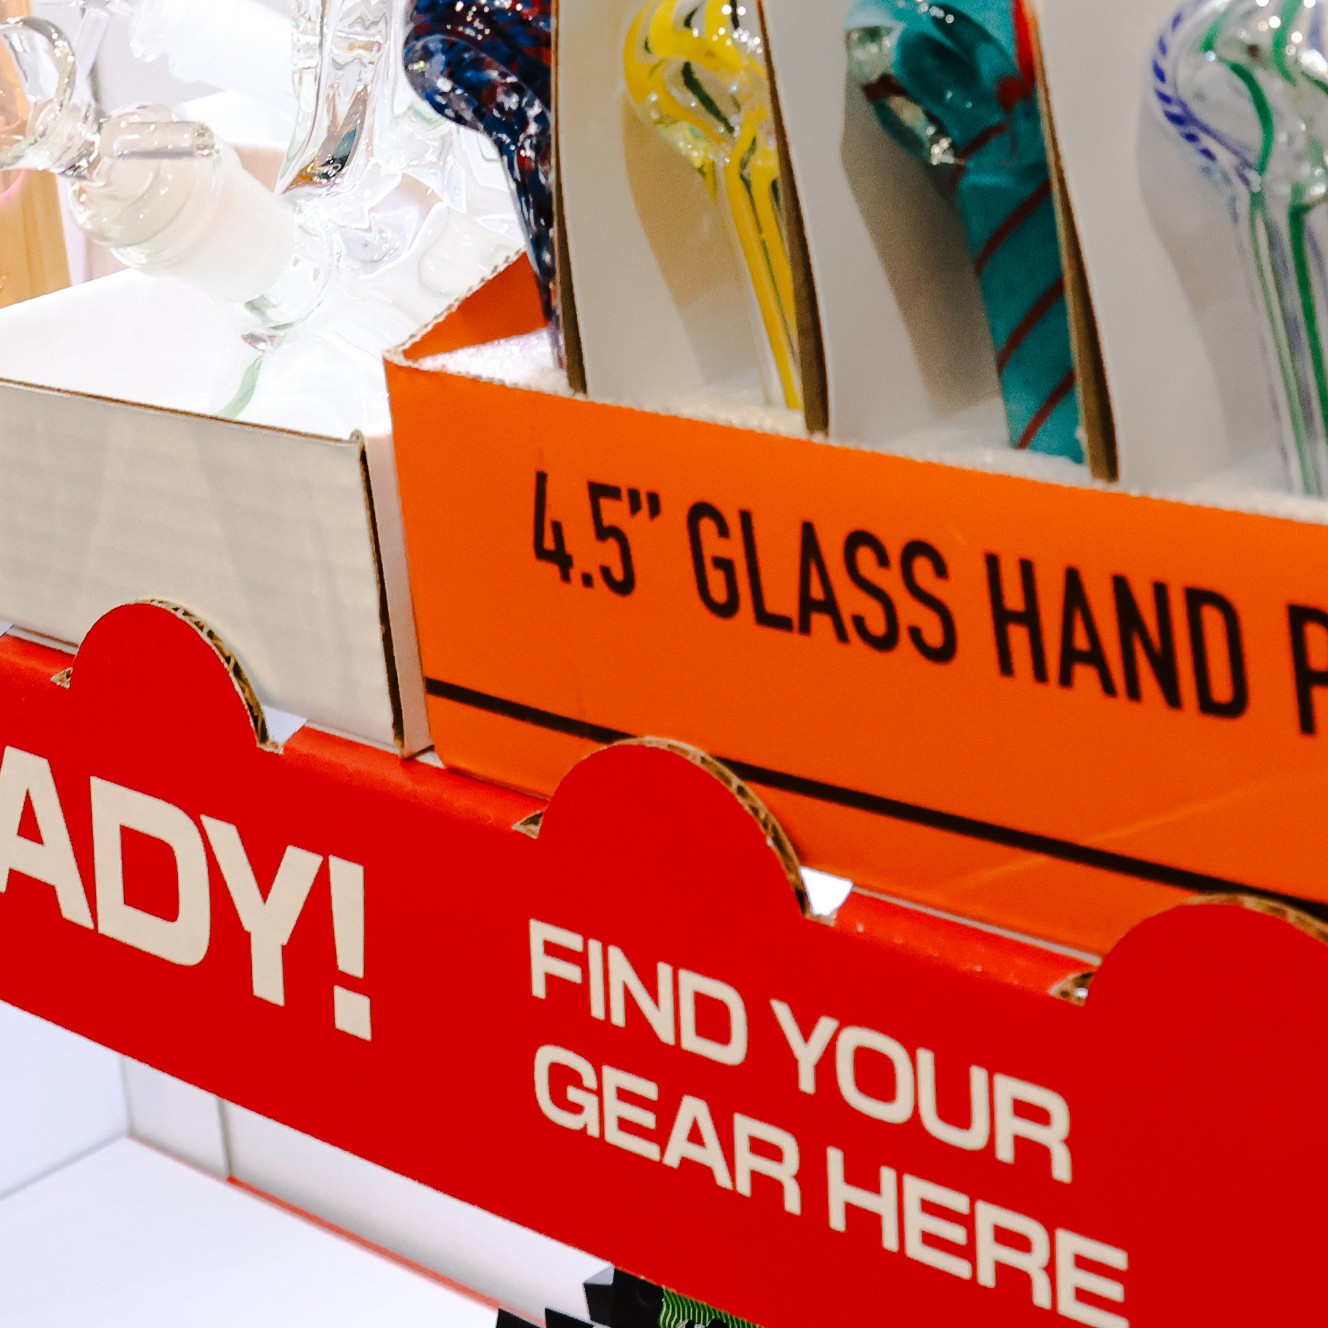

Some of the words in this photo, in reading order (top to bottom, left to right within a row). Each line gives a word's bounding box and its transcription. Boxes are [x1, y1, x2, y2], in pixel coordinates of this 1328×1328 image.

[686, 501, 958, 665] GLASS
[983, 551, 1250, 719] HAND
[528, 918, 749, 1067] FIND
[769, 998, 1073, 1184] YOUR
[532, 1044, 802, 1216] GEAR
[826, 1145, 1130, 1328] HERE
